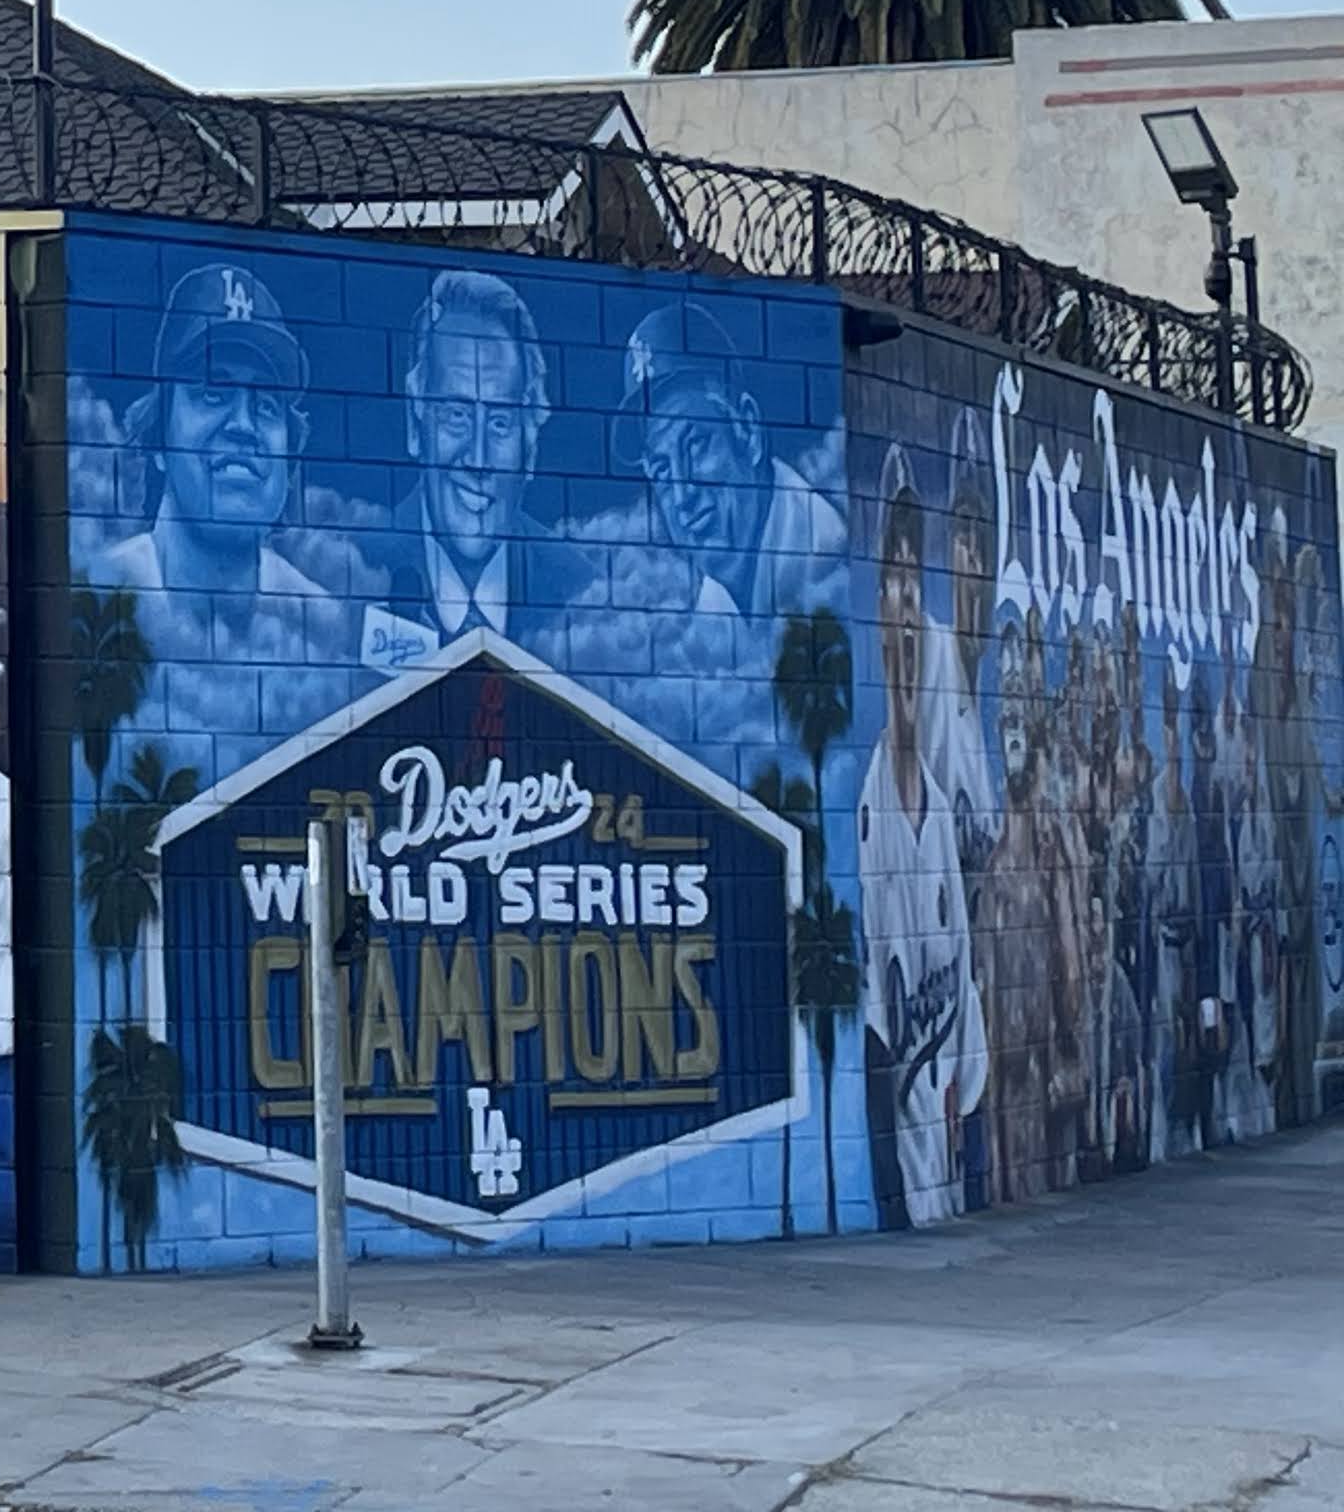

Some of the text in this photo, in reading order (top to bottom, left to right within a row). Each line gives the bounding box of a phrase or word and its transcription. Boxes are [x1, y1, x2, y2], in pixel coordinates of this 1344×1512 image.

[221, 270, 253, 321] LA
[992, 361, 1261, 692] Los Angeles
[379, 745, 594, 875] Dodgers
[590, 793, 644, 850] 24
[240, 862, 711, 928] WRLD SERIES
[467, 1087, 523, 1197] LA
